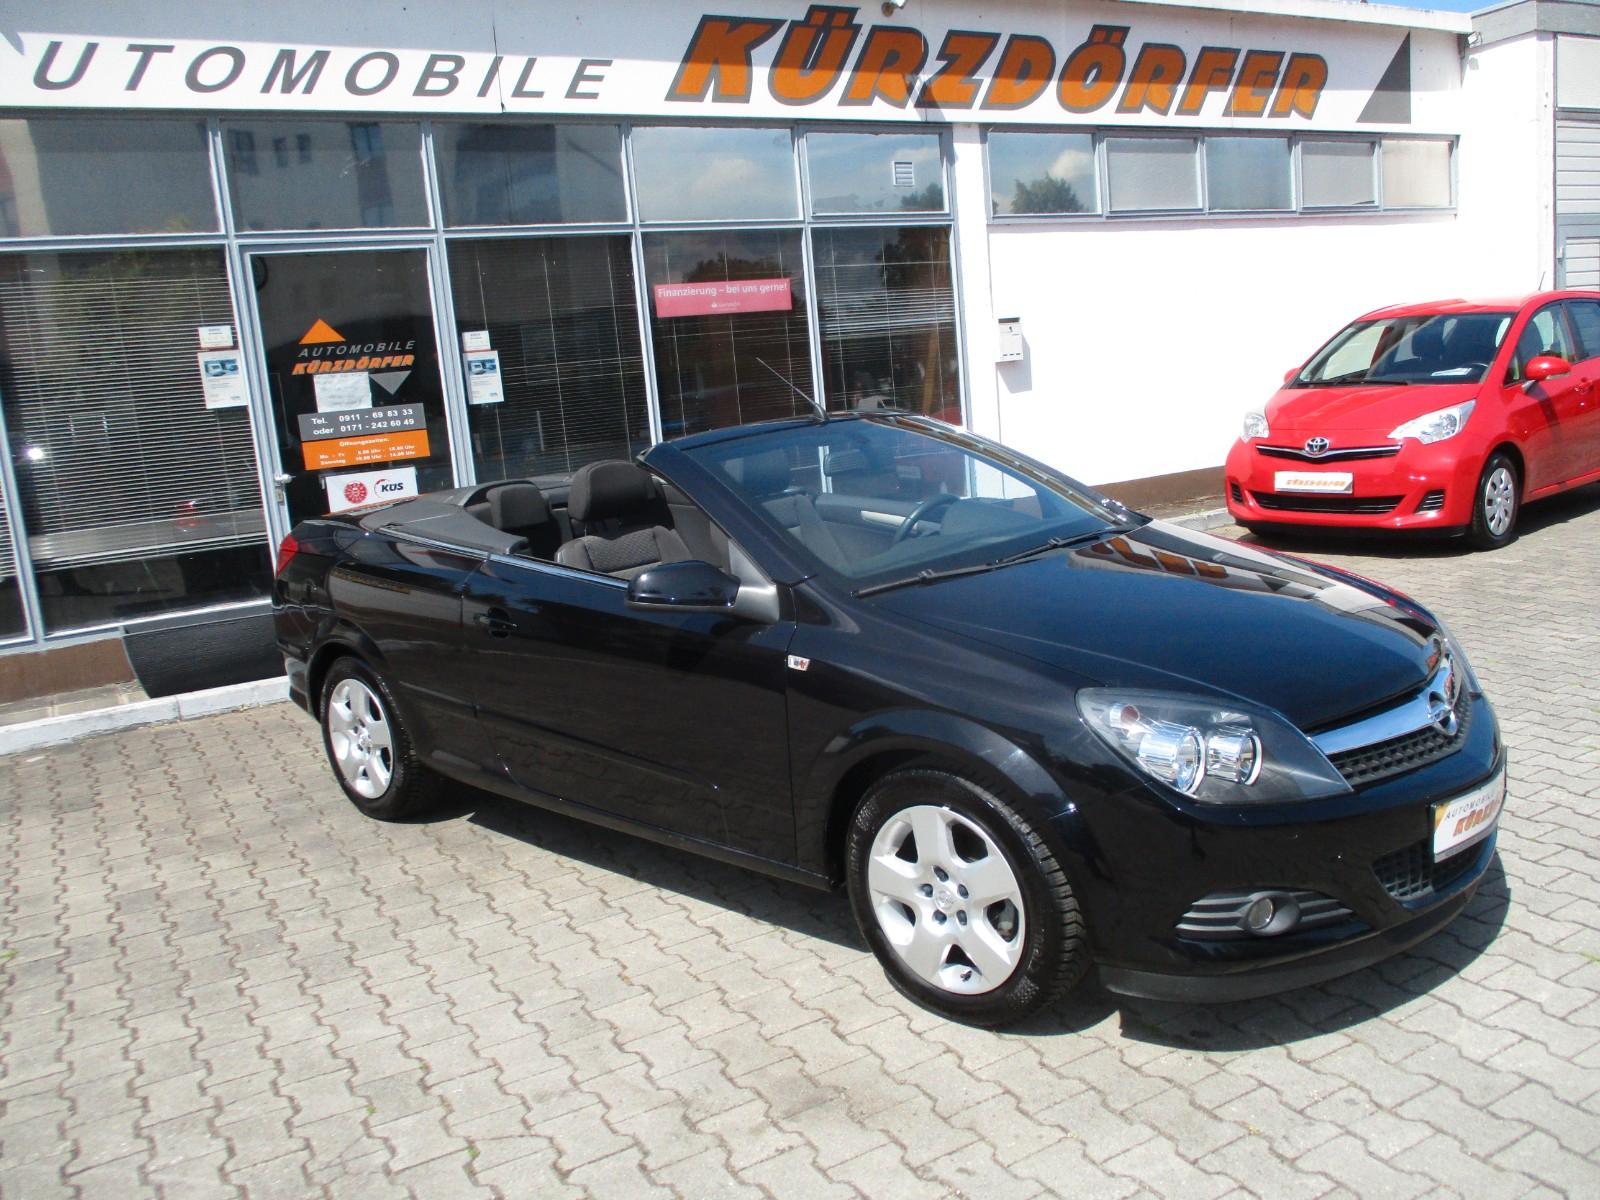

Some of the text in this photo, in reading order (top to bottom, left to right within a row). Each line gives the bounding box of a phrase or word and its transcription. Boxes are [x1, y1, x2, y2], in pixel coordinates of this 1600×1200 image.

[33, 4, 1329, 119] UTOMOBILE KÜRZDÖRFER
[657, 286, 717, 298] Finanzierung
[726, 284, 740, 294] bei
[743, 284, 757, 293] uns
[760, 283, 788, 294] gerne!
[298, 340, 416, 358] AUTOMOBILE
[291, 354, 416, 375] KÜRZDÖRFER
[311, 417, 329, 426] Tel.
[339, 413, 360, 422] 0911
[372, 411, 383, 419] 69
[387, 410, 398, 418] 83
[402, 408, 413, 416] 33
[313, 427, 334, 435] oder
[340, 422, 362, 432] 0171
